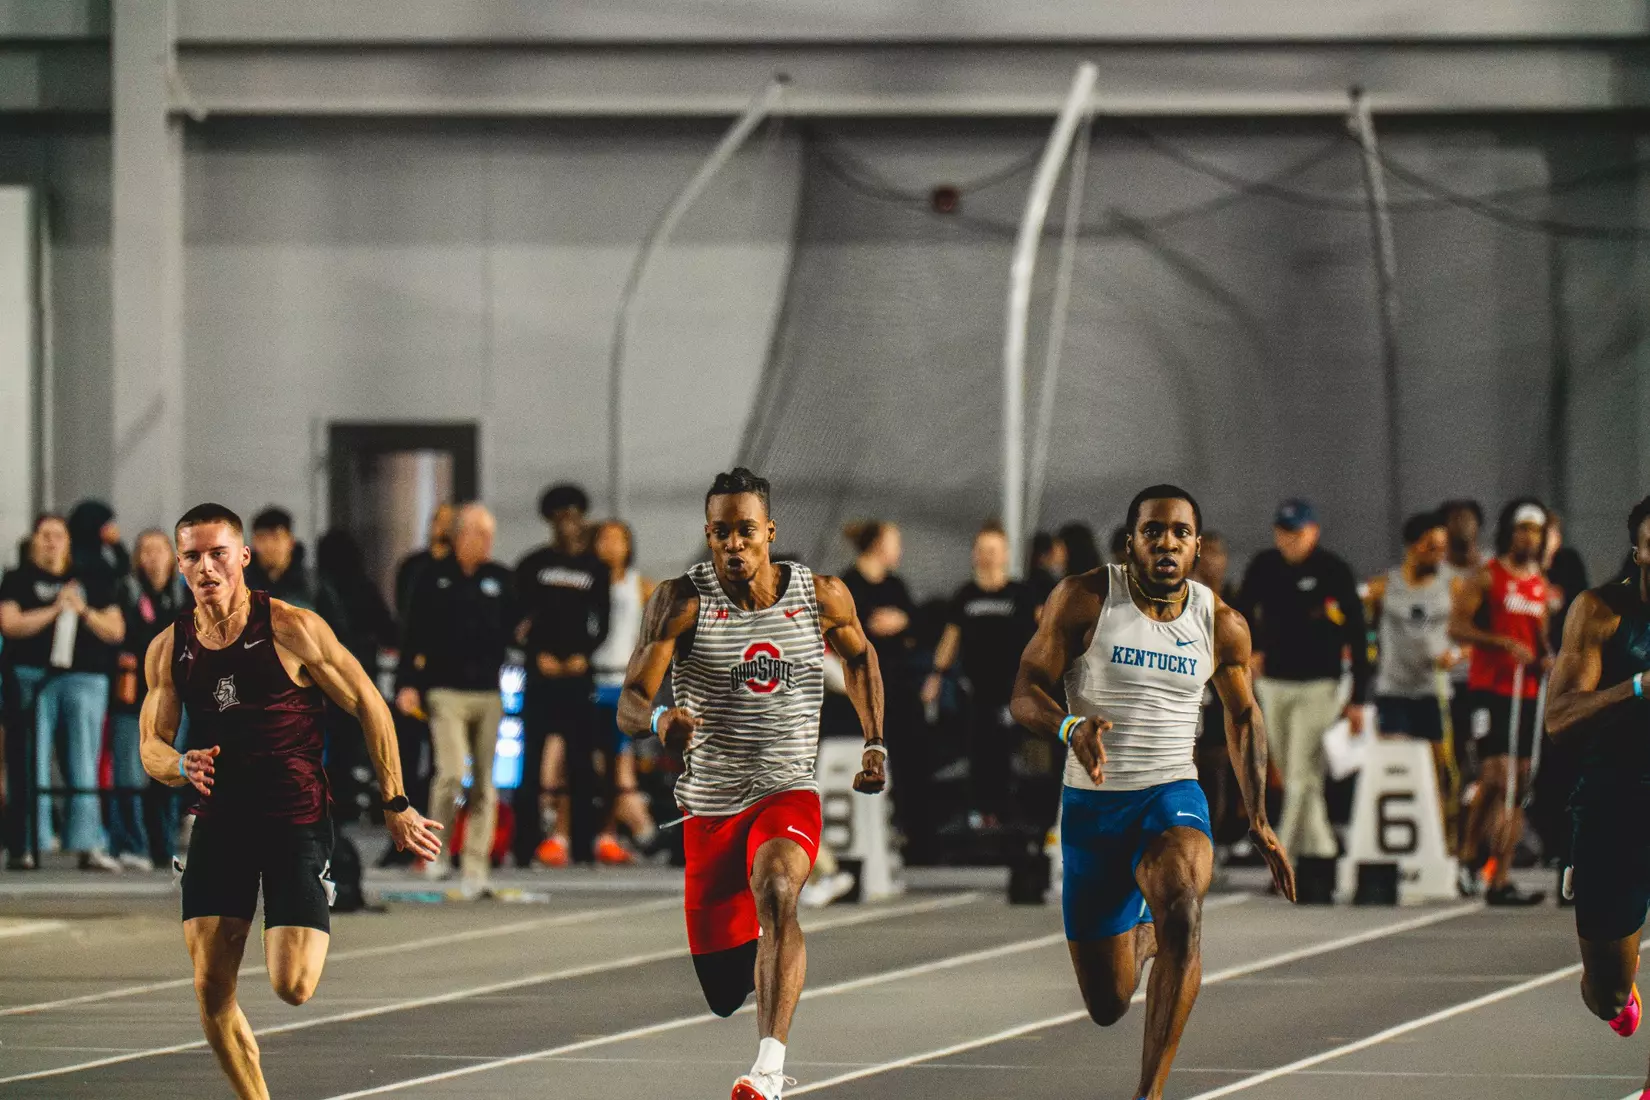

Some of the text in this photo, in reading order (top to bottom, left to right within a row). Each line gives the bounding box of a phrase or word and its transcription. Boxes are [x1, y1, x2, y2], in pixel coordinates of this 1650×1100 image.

[730, 660, 758, 692] OHIO
[1110, 645, 1198, 676] KENTUCKY
[1378, 790, 1418, 853] 6
